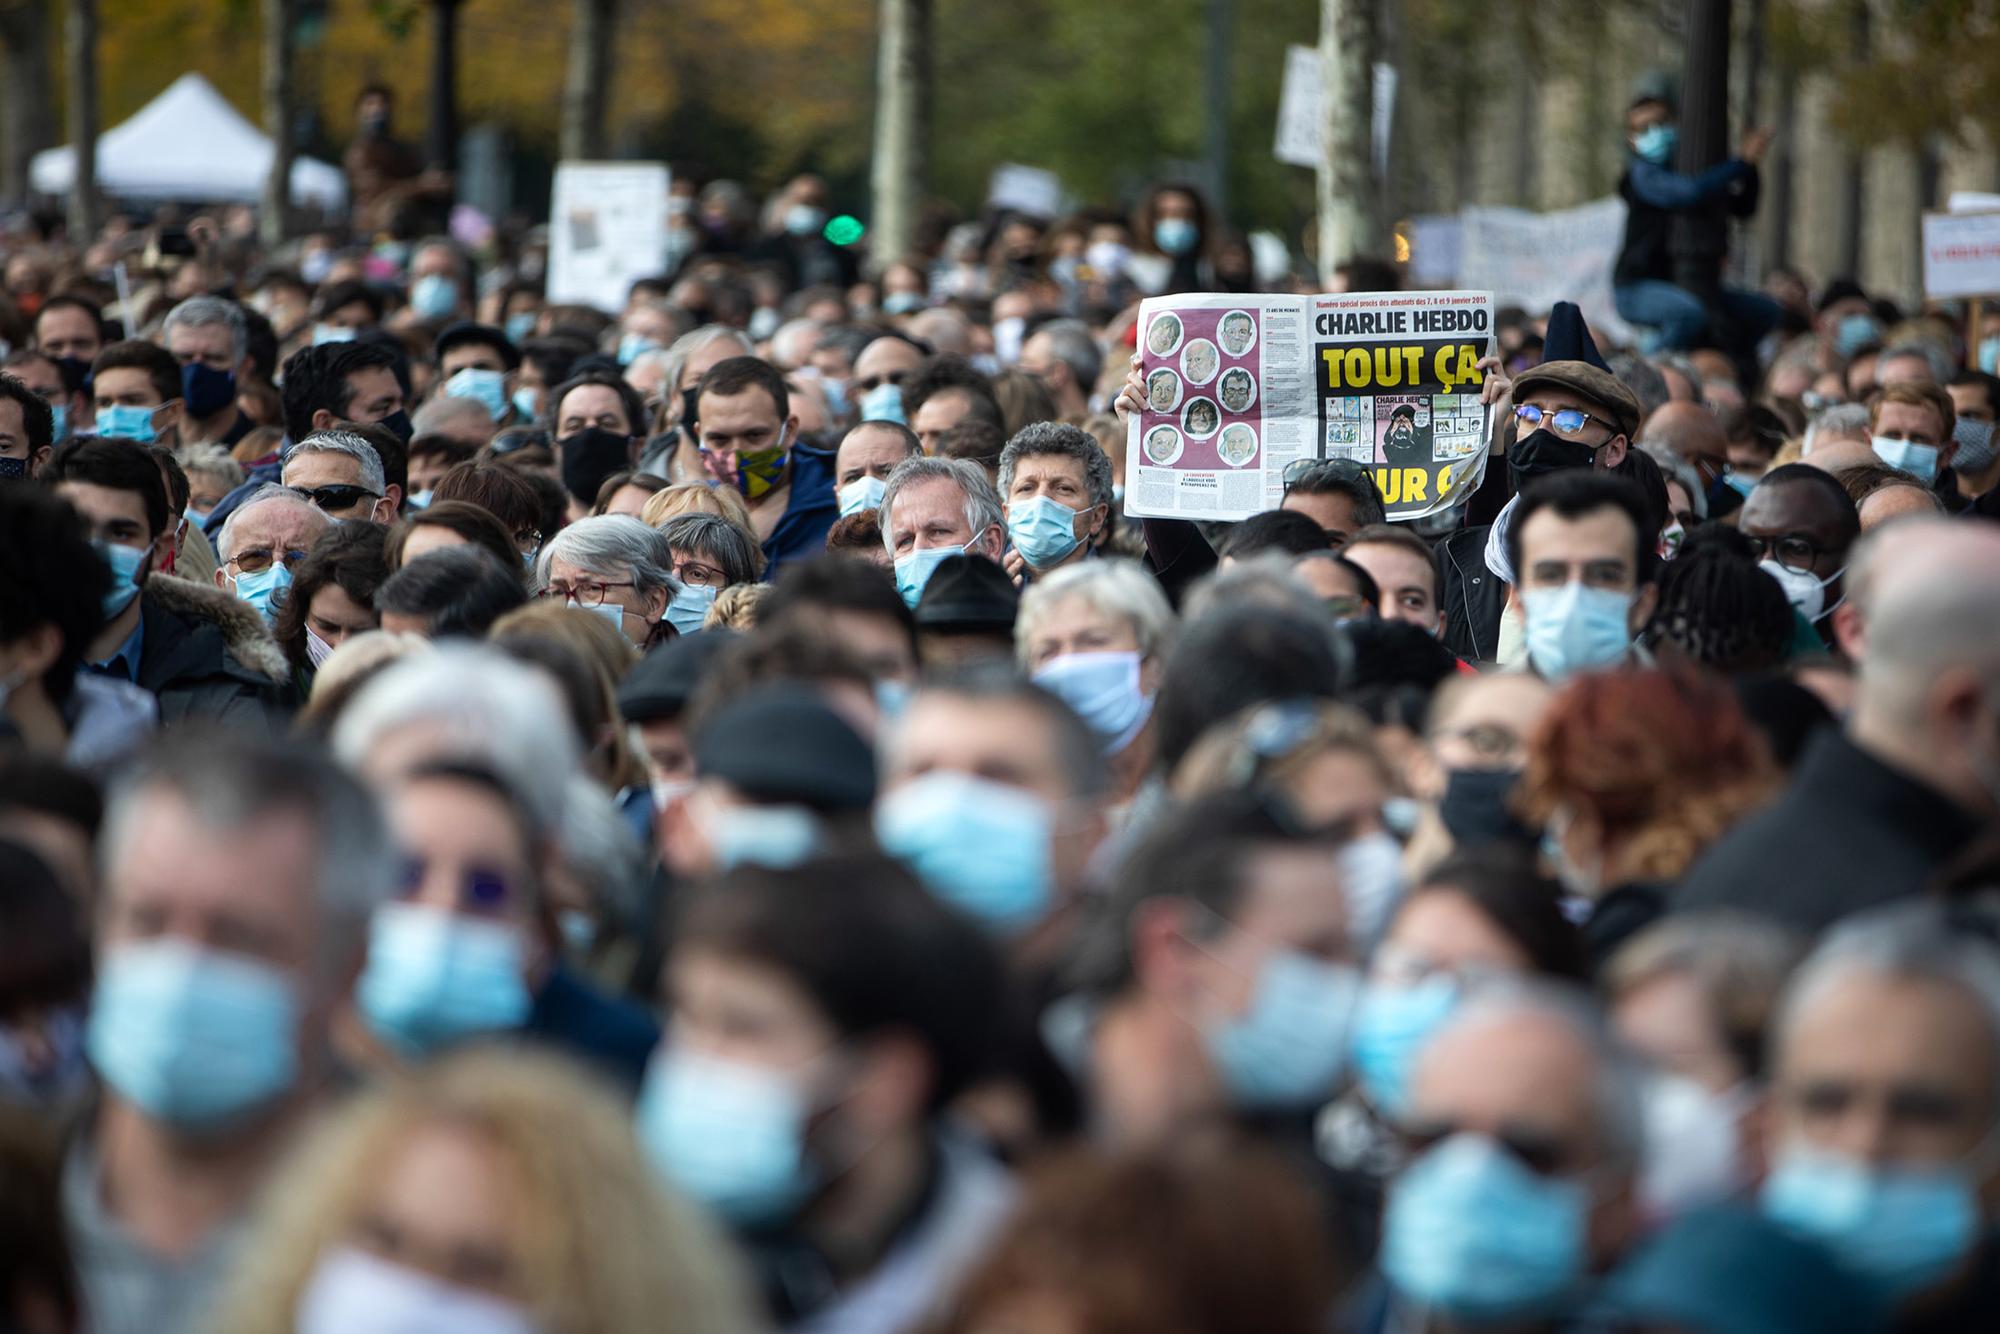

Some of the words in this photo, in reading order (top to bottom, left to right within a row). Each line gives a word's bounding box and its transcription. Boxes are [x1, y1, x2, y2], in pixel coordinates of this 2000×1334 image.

[1316, 301, 1338, 309] Numéro
[1340, 300, 1359, 309] spécial
[1360, 299, 1378, 308] procès
[1390, 298, 1415, 306] attentats
[1416, 297, 1426, 306] des
[1446, 297, 1451, 305] 9
[1451, 296, 1471, 305] janvier
[1472, 296, 1487, 304] 2015
[1315, 312, 1406, 336] CHARLIE
[1413, 309, 1488, 333] HEBDO
[1323, 346, 1425, 388] TOUT
[1434, 345, 1484, 394] ÇA
[1376, 396, 1406, 404] CHARLIE
[1362, 467, 1428, 504] UR
